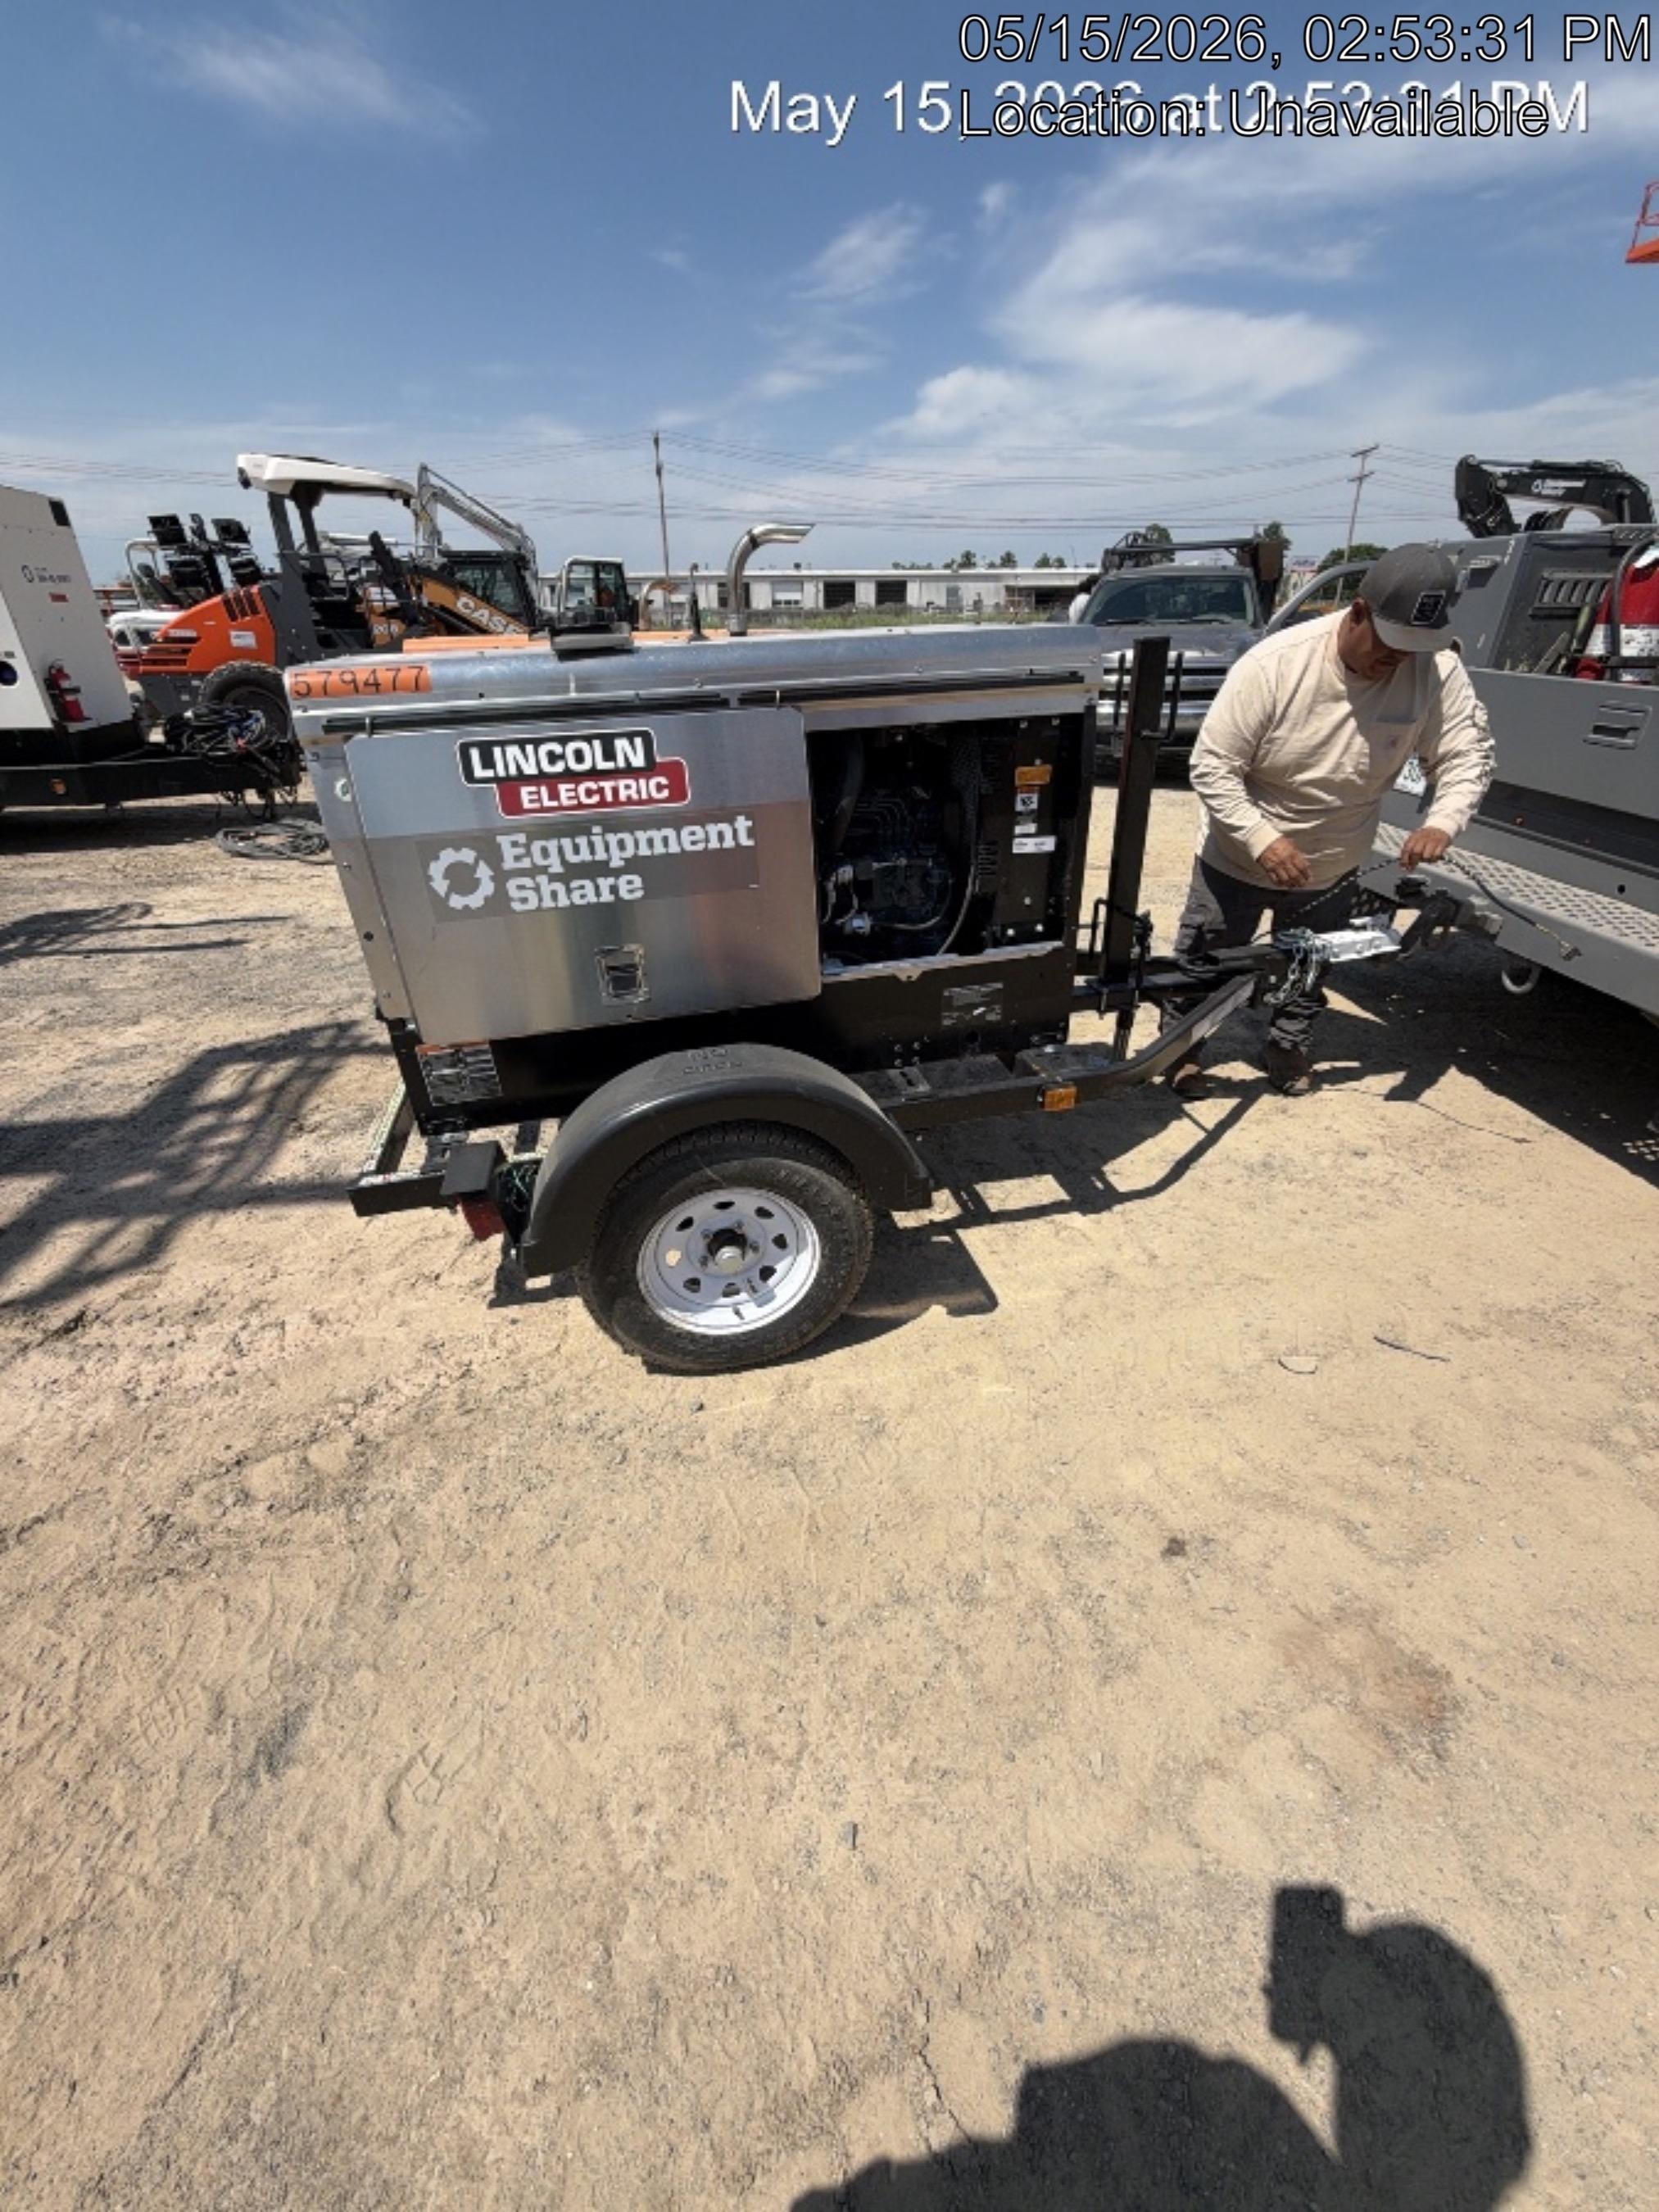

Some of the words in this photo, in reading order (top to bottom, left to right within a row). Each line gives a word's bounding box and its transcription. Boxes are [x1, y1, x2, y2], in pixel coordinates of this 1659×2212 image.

[294, 666, 423, 696] 579477
[469, 737, 646, 778] LINCOLN
[520, 776, 669, 809] ELECTRIC
[496, 815, 755, 873] Equipment
[506, 873, 644, 912] Share
